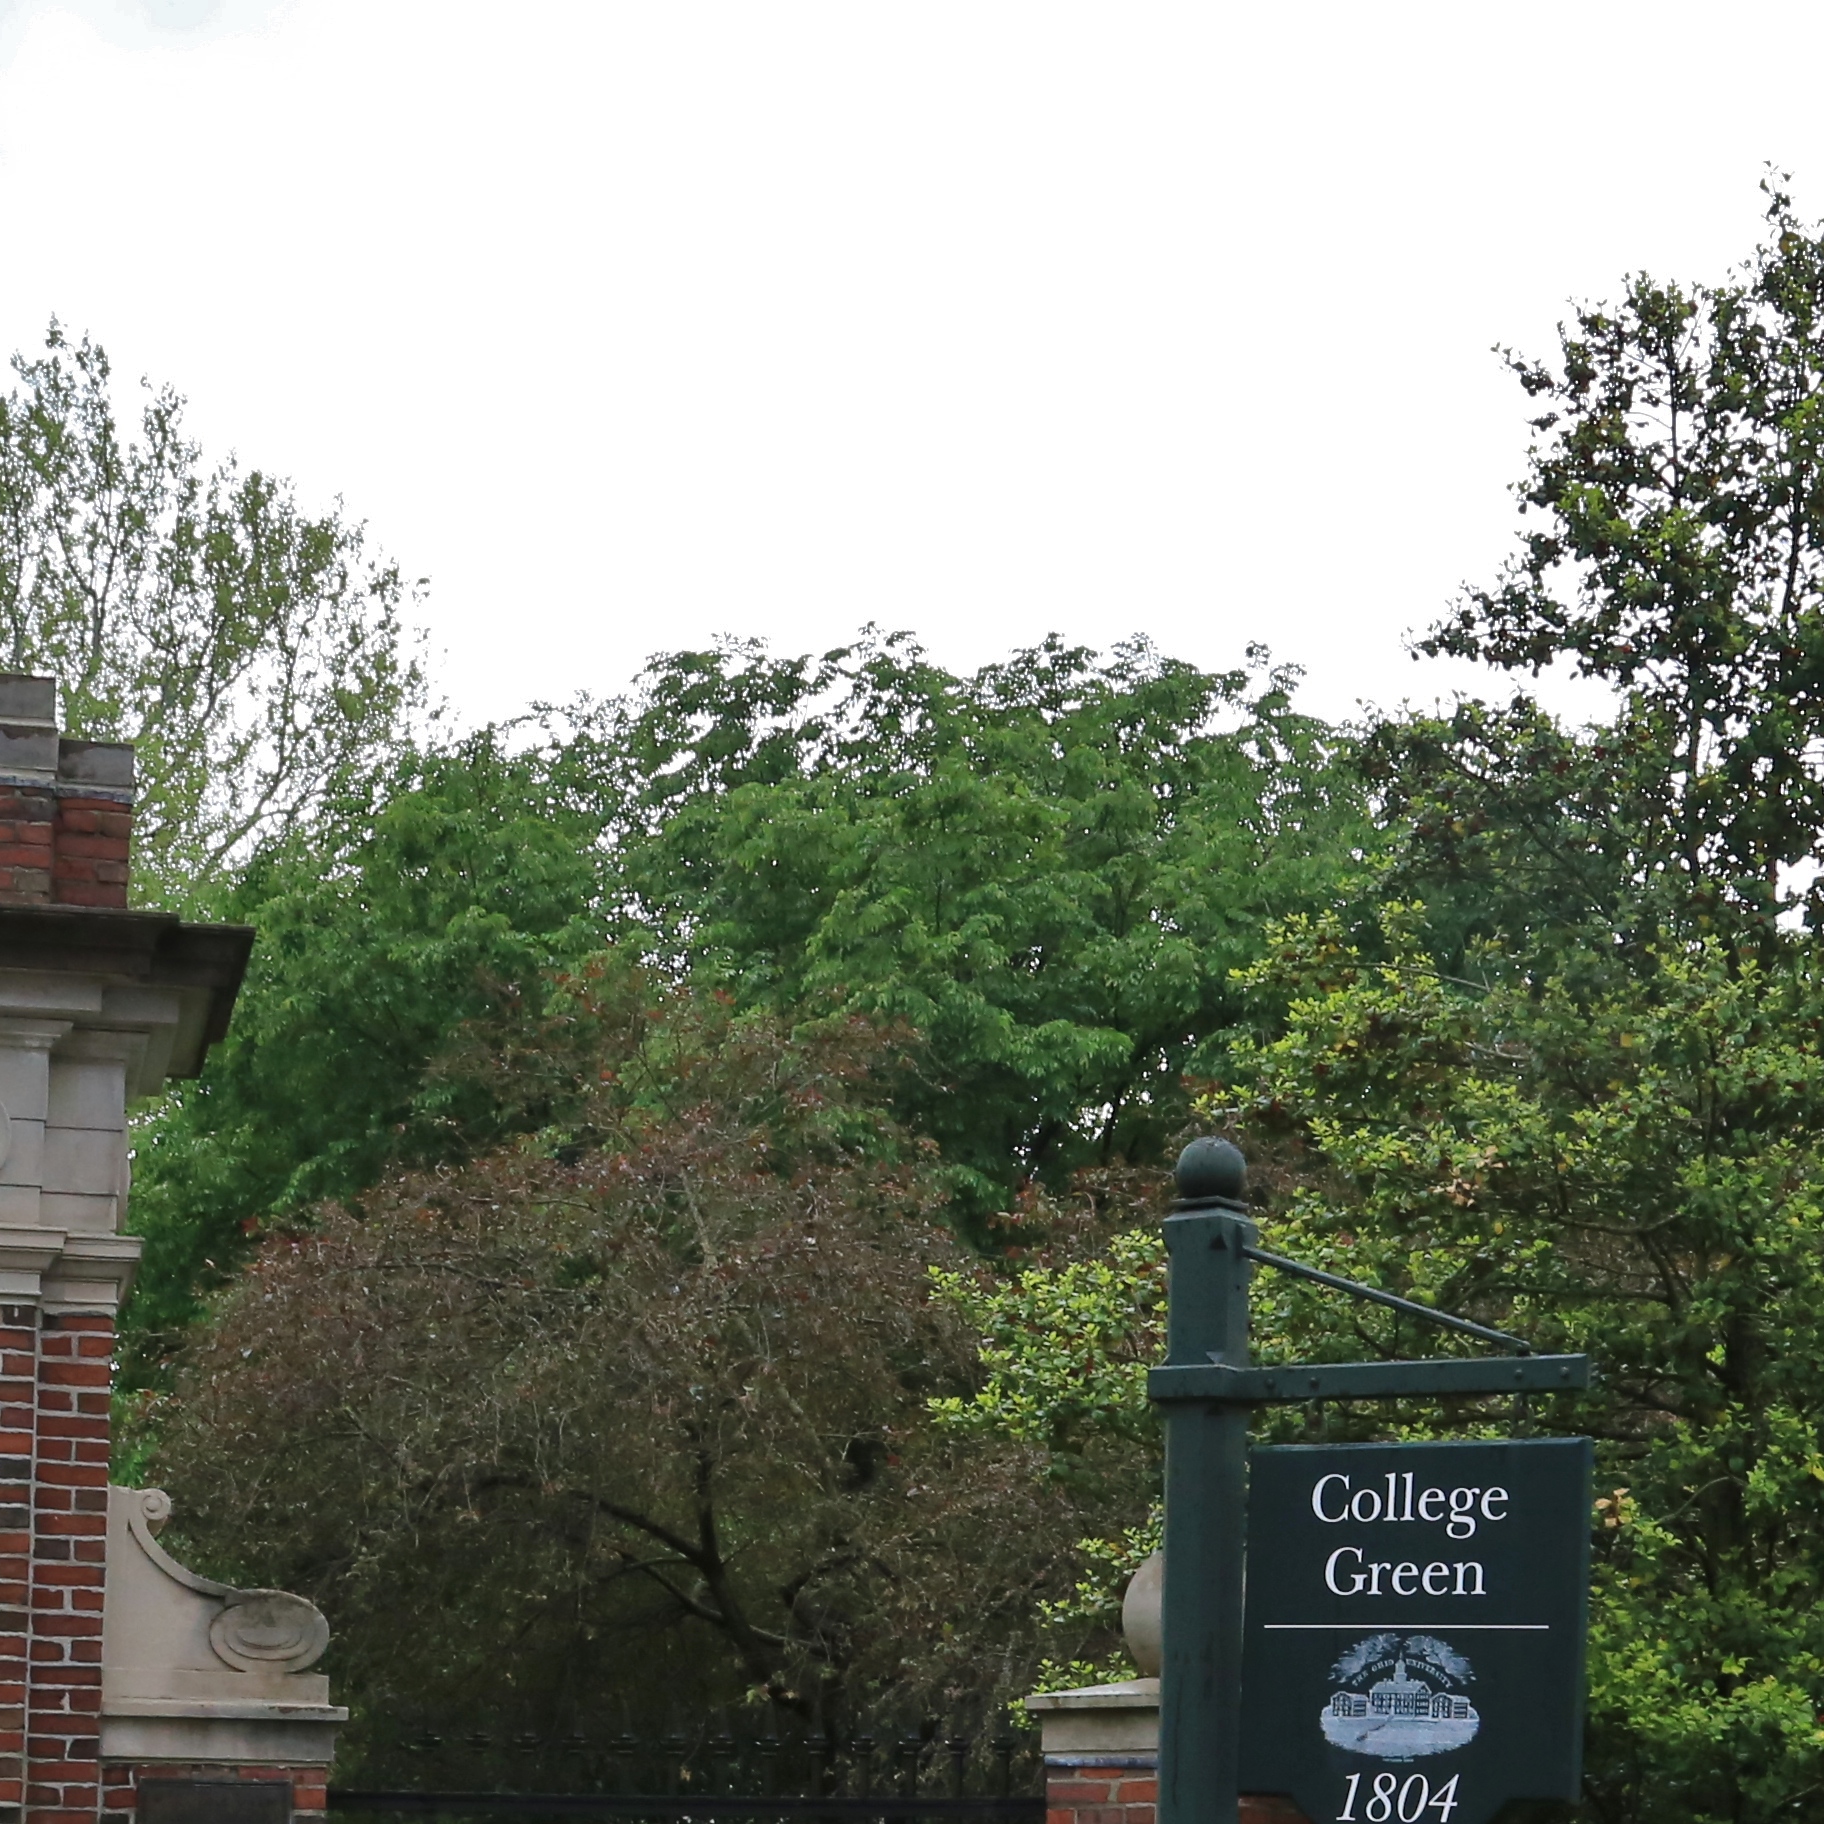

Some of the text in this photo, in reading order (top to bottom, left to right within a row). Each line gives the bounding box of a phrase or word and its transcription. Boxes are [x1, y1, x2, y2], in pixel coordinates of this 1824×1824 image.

[1311, 1472, 1509, 1540] College
[1324, 1546, 1487, 1597] Green
[1351, 1658, 1454, 1689] THE OHIO UNIVERSITY
[1335, 1772, 1460, 1824] 1804
